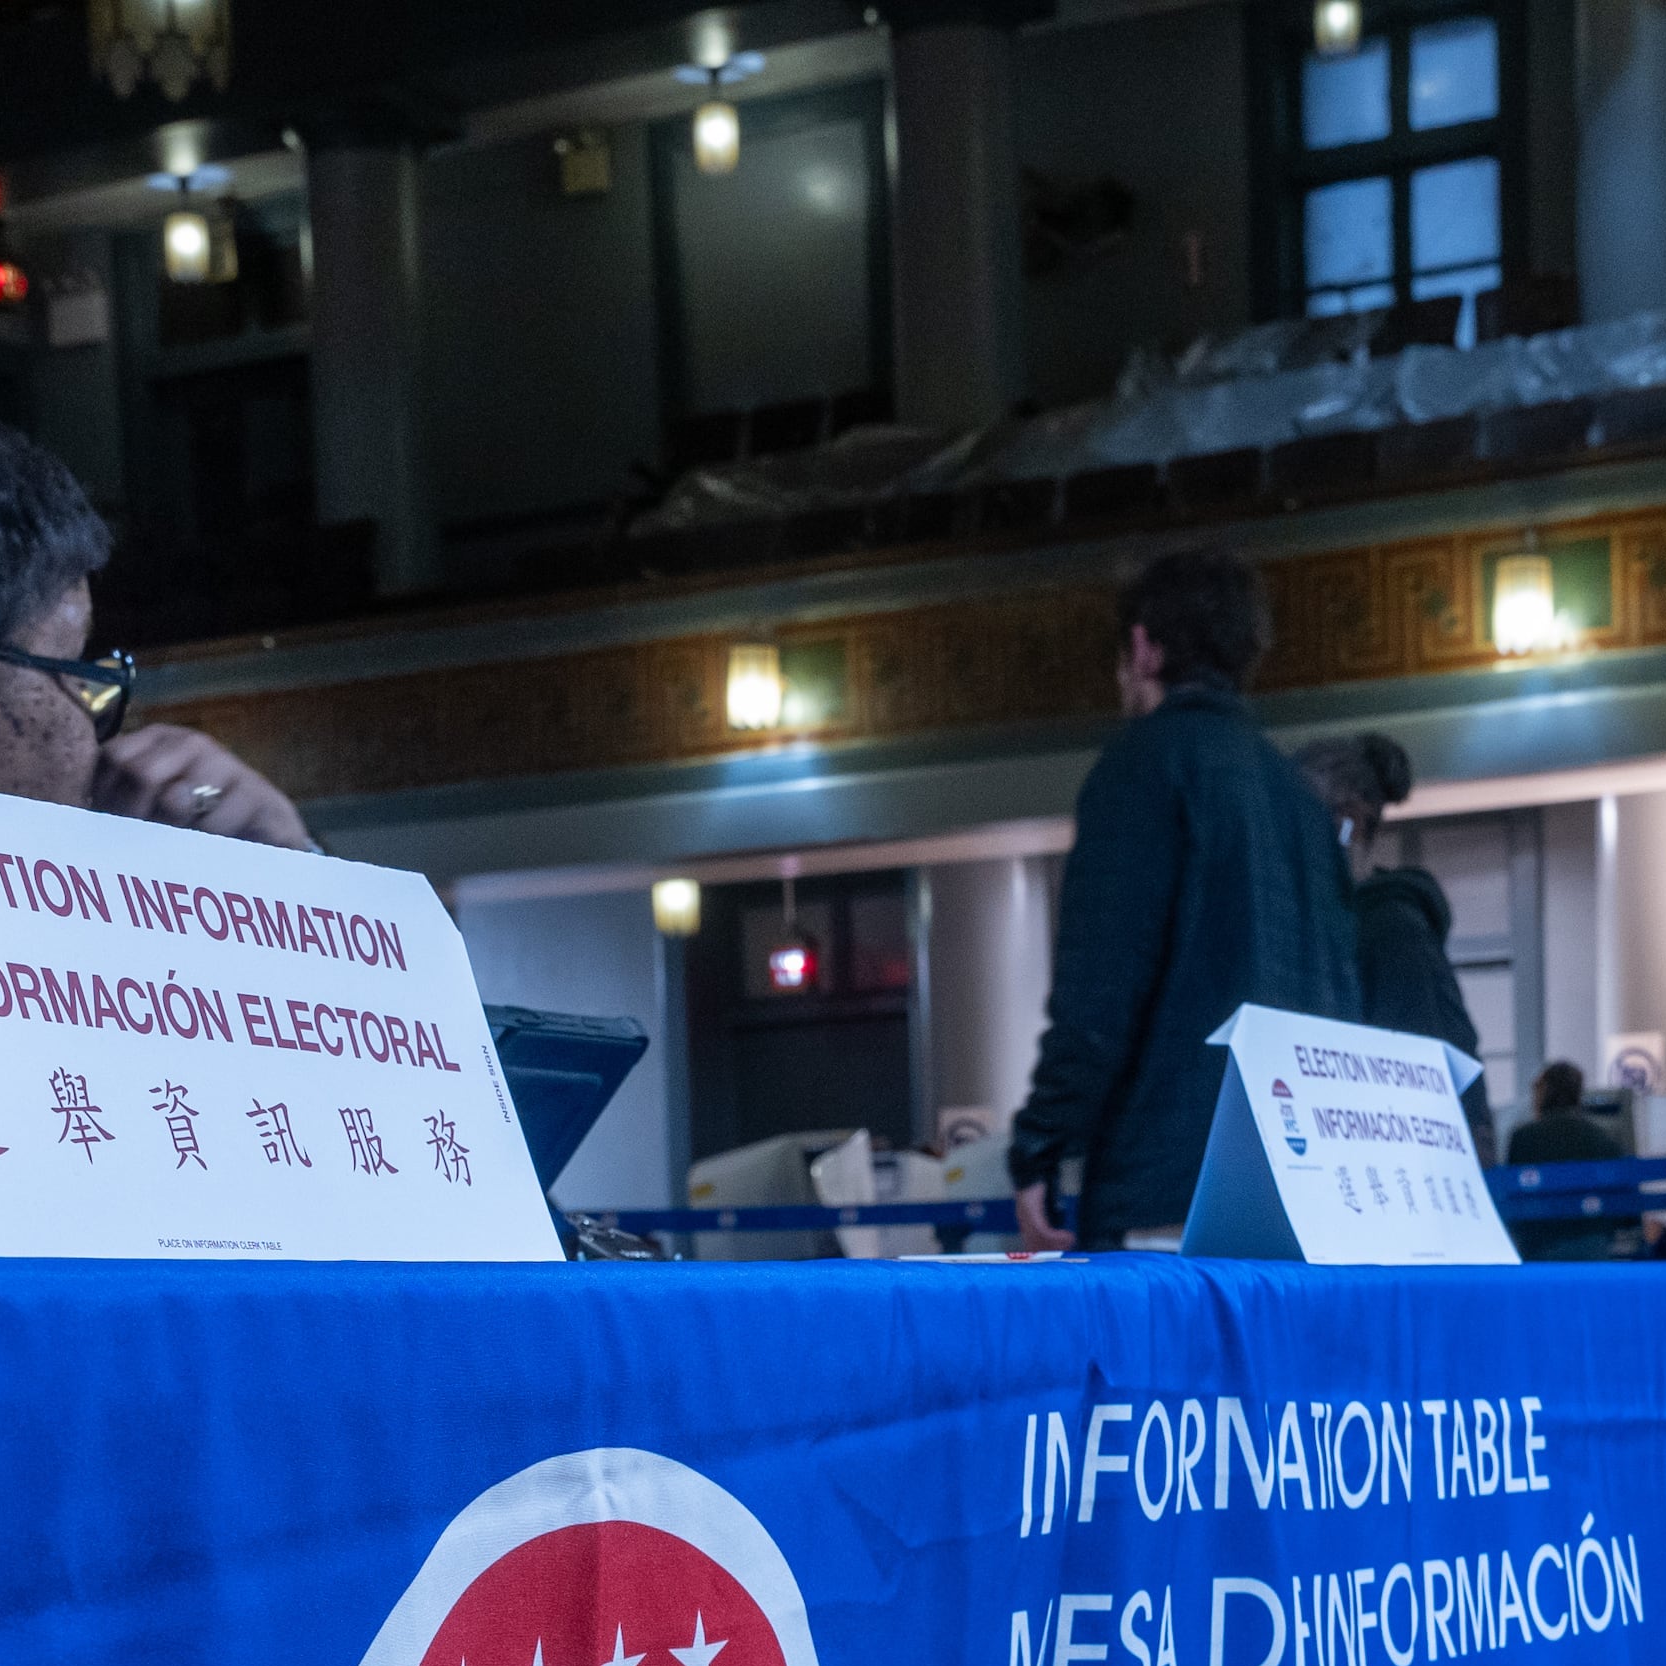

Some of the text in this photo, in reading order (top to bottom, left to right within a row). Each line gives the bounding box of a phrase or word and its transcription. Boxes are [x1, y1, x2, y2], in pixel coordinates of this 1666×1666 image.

[117, 874, 407, 971] INFORMATION
[237, 993, 461, 1072] ELECTORAL
[1294, 1045, 1369, 1083] ELECTION
[481, 1044, 511, 1123] INSIDE SIGN
[158, 1238, 283, 1251] PLACE ON INFORMATION CLERK TABLE
[1422, 1396, 1550, 1500] TABLE
